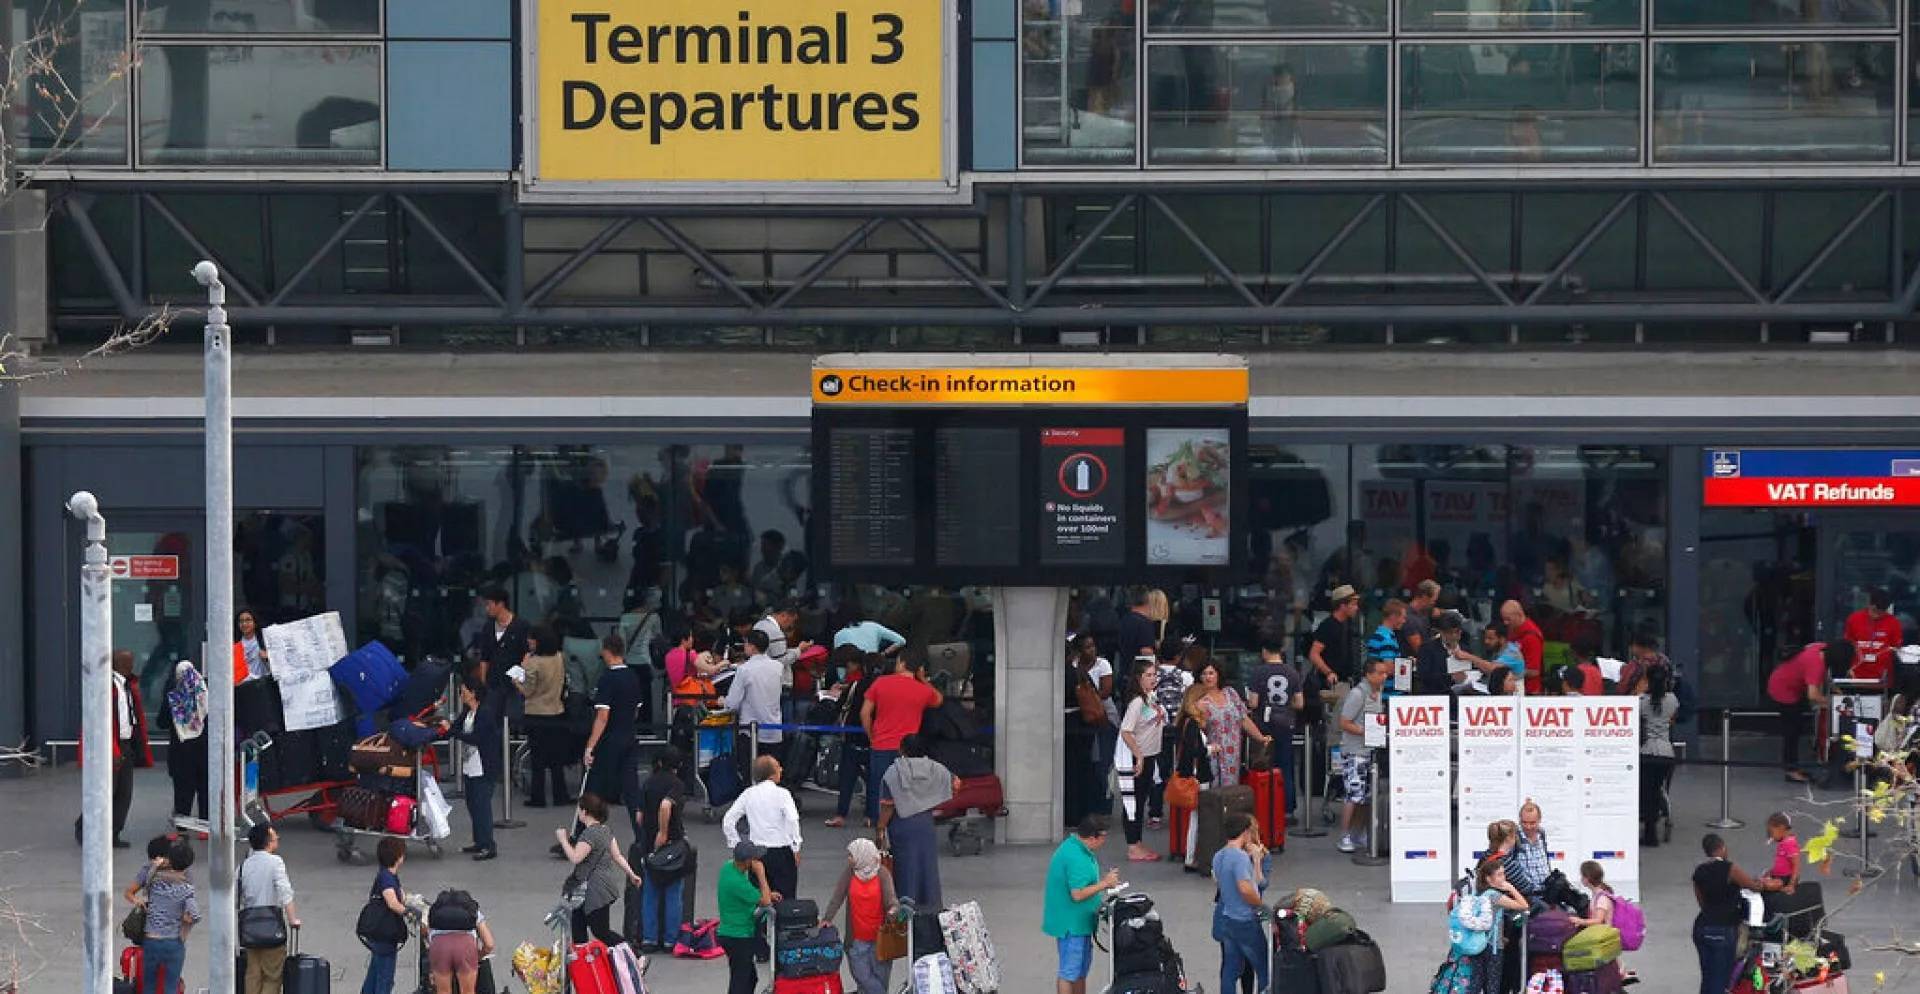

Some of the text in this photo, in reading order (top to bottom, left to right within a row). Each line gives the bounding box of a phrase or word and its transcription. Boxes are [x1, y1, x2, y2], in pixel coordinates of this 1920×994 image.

[571, 11, 905, 65] Terminal 3
[562, 80, 920, 145] Departures
[849, 375, 1076, 392] Check-in information
[1767, 483, 1895, 500] VAT Refunds
[1072, 504, 1104, 513] liquids
[1057, 514, 1117, 522] in containers
[1081, 525, 1109, 533] 100ml
[1267, 675, 1289, 705] 8
[1396, 706, 1445, 726] VAT
[1465, 706, 1513, 726] VAT
[1526, 707, 1574, 727] VAT
[1585, 706, 1634, 726] VAT
[1395, 728, 1445, 737] REFUNDS
[1464, 728, 1514, 737] REFUNDS
[1525, 729, 1574, 738] REFUNDS
[1584, 728, 1634, 737] REFUNDS
